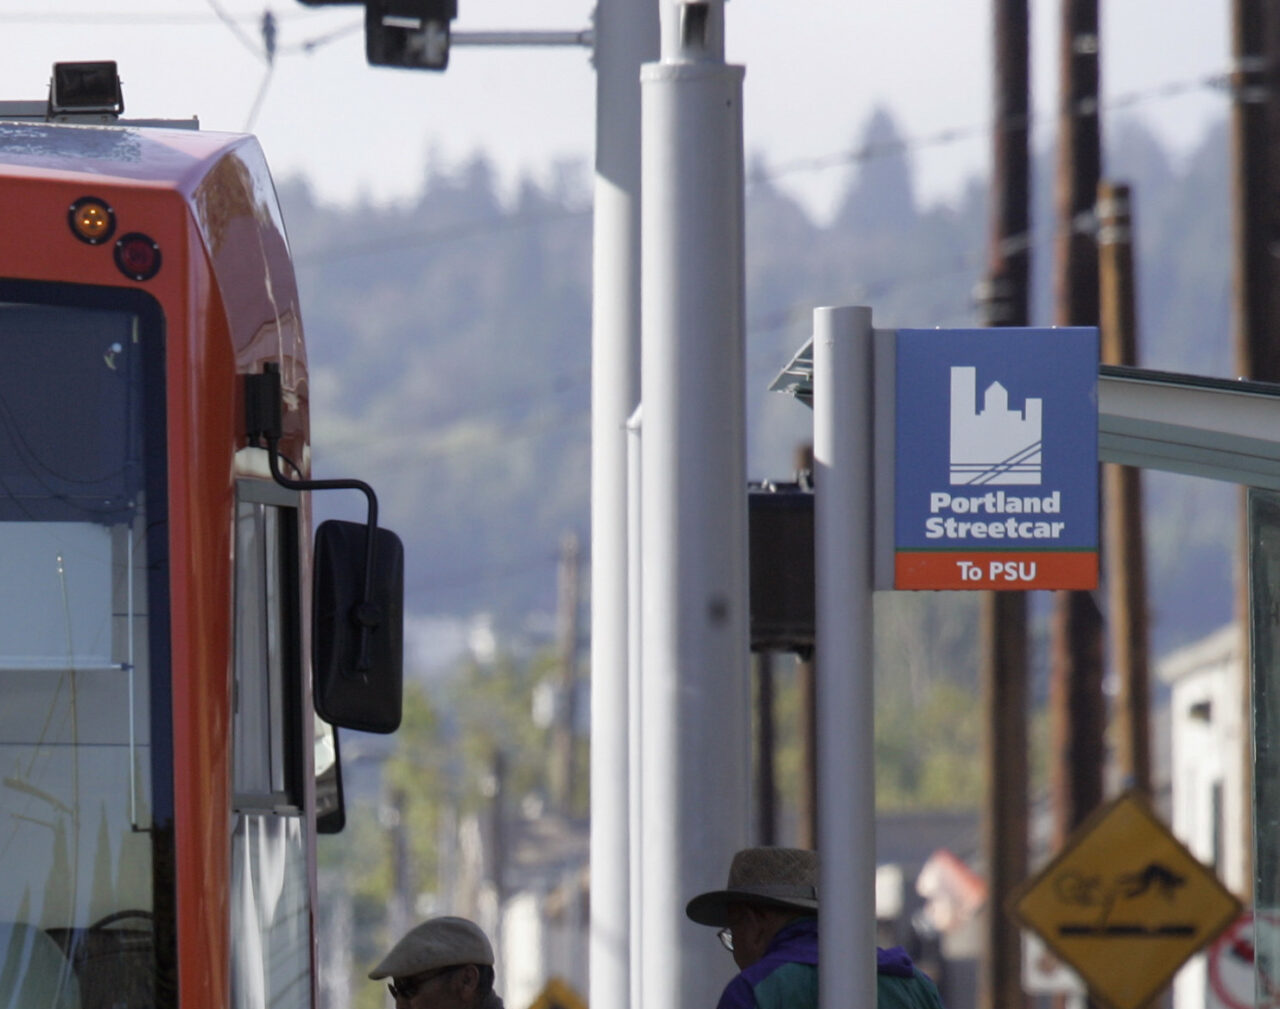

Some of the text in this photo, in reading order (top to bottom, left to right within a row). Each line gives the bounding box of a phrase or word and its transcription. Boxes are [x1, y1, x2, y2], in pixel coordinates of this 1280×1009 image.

[930, 491, 1060, 514] Portland
[925, 517, 1065, 538] Streetcar
[956, 561, 1036, 581] To PSU
